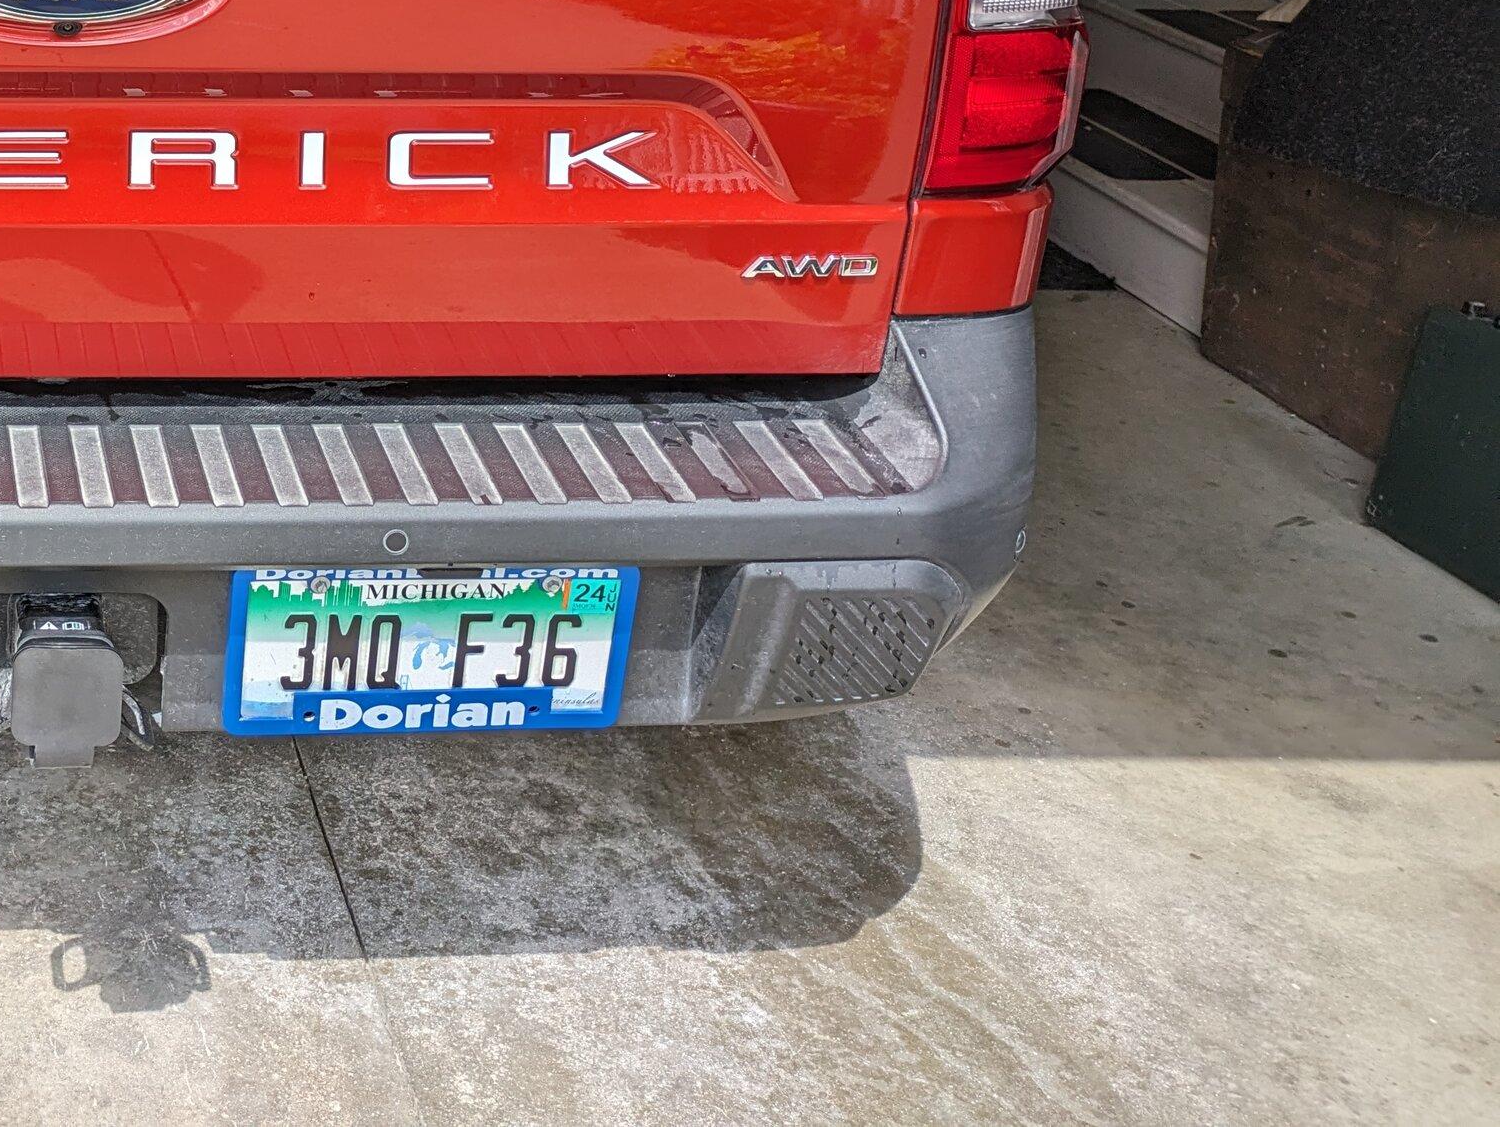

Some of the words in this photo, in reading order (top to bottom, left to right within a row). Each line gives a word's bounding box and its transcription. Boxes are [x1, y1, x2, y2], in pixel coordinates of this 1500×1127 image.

[741, 255, 879, 279] AWD
[365, 582, 508, 601] MICHIGAN
[573, 583, 607, 603] 24
[605, 583, 618, 612] JUN
[279, 613, 402, 692] 3MQ
[452, 612, 583, 688] F36
[318, 692, 525, 731] Dorian
